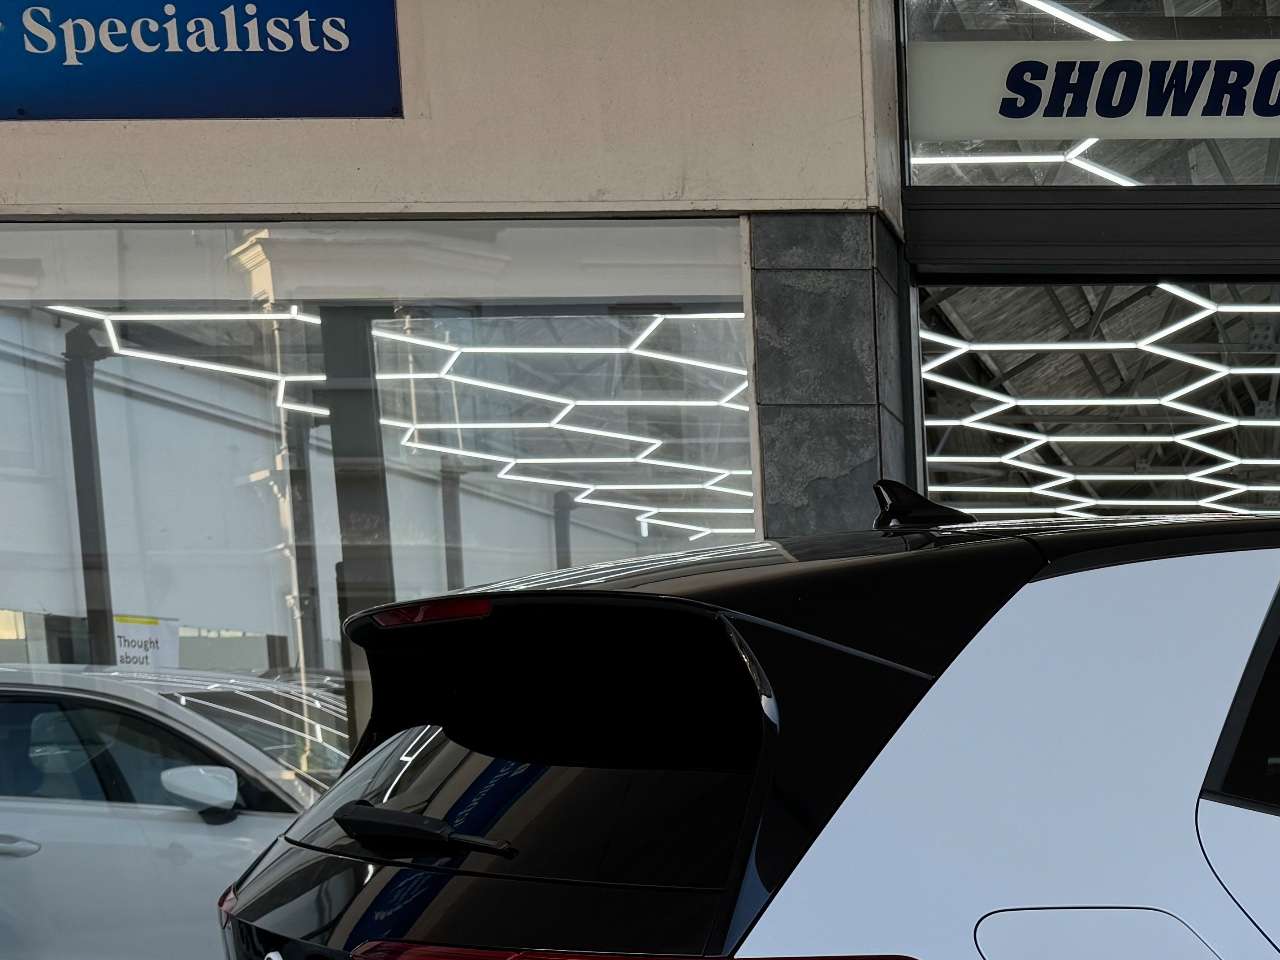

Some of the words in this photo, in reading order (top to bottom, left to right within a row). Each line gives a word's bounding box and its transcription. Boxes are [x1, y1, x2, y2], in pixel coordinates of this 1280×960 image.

[21, 3, 351, 67] Specialists
[117, 635, 160, 652] Thought
[119, 652, 150, 665] about
